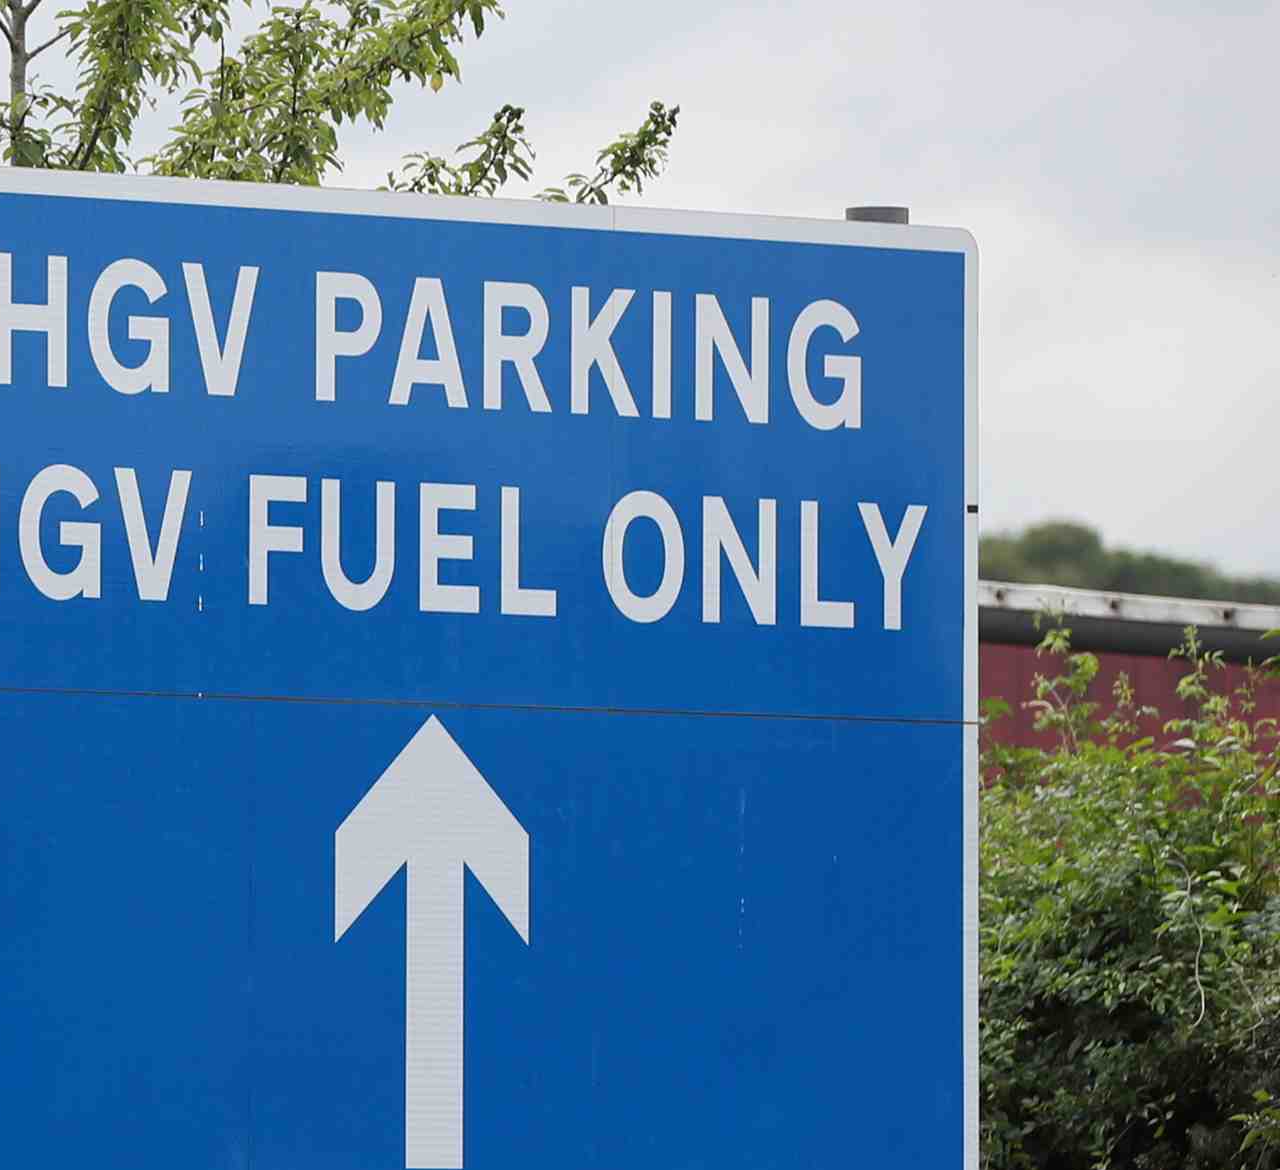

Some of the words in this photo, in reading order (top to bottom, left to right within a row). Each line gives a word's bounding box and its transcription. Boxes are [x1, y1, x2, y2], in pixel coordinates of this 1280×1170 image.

[316, 272, 861, 430] PARKING
[249, 475, 556, 616] FUEL
[603, 491, 927, 629] ONLY
